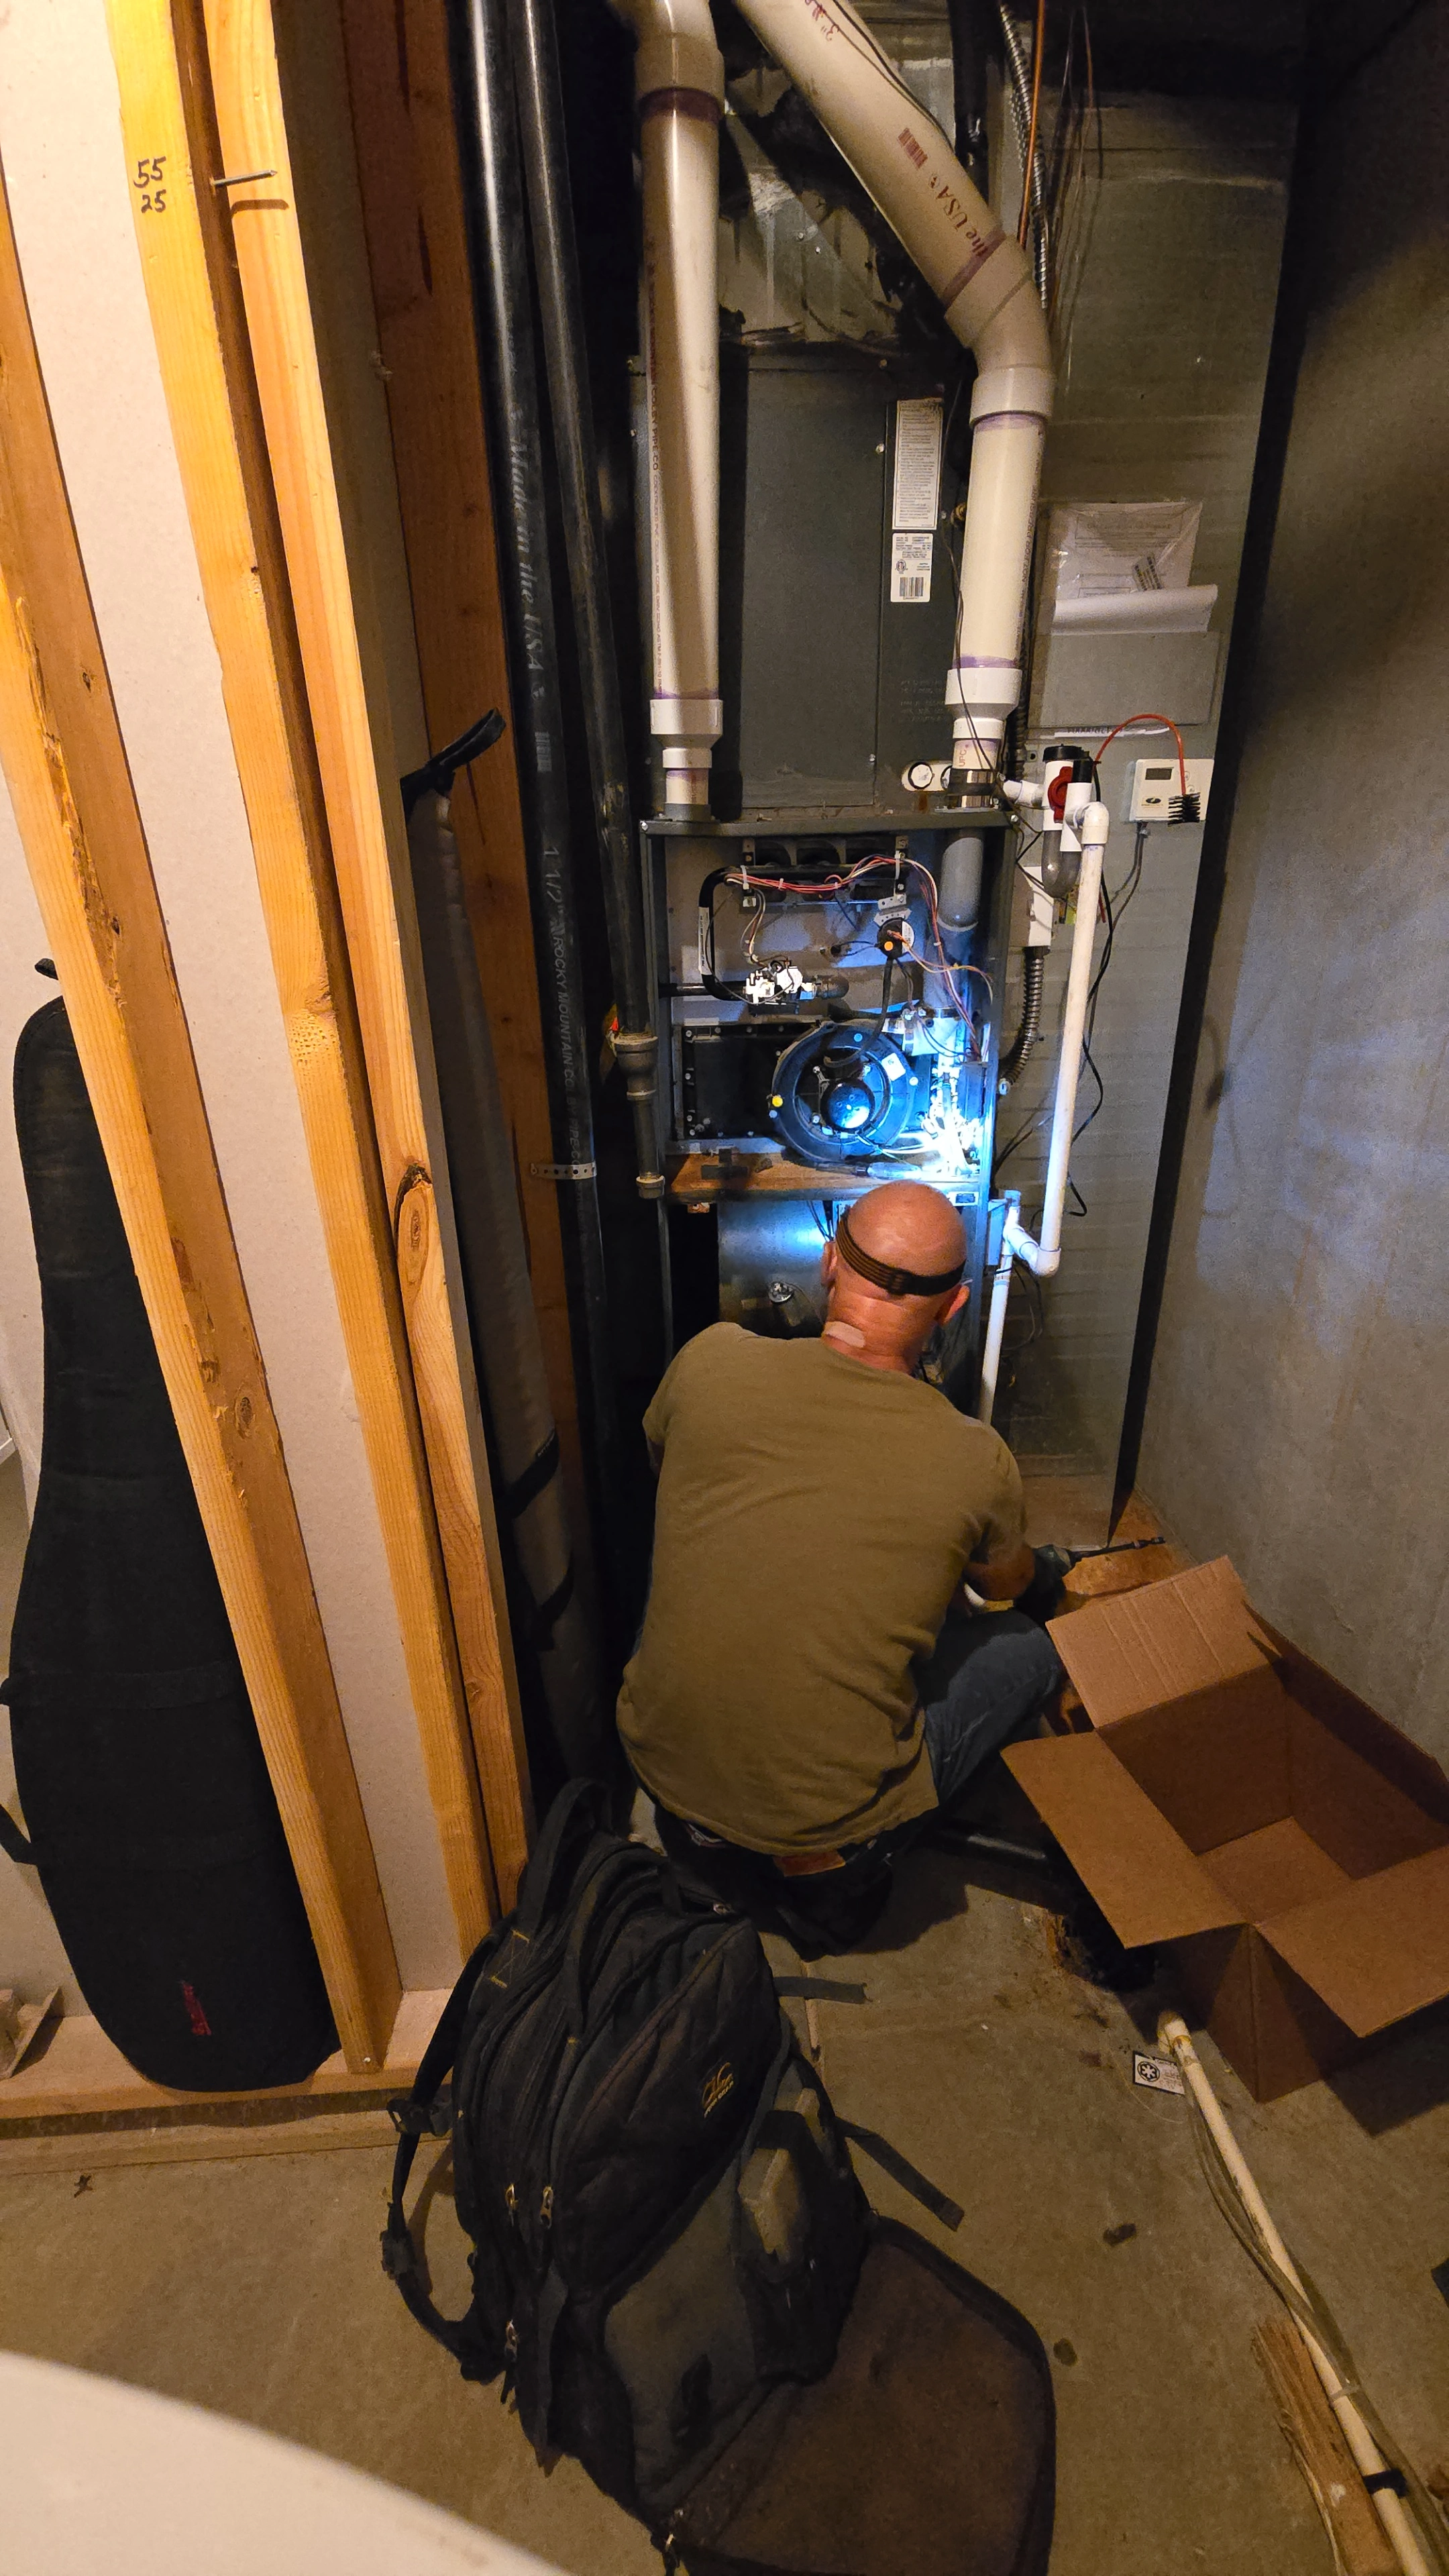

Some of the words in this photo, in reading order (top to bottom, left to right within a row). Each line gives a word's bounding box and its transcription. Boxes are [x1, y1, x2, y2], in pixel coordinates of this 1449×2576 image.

[133, 156, 166, 189] 55
[141, 189, 166, 213] 25
[936, 186, 967, 232] USA
[519, 562, 537, 604] the
[523, 613, 545, 670] USA
[959, 749, 967, 767] UPC
[553, 936, 568, 989] ROCKY
[557, 991, 574, 1065] MOUNTAIN
